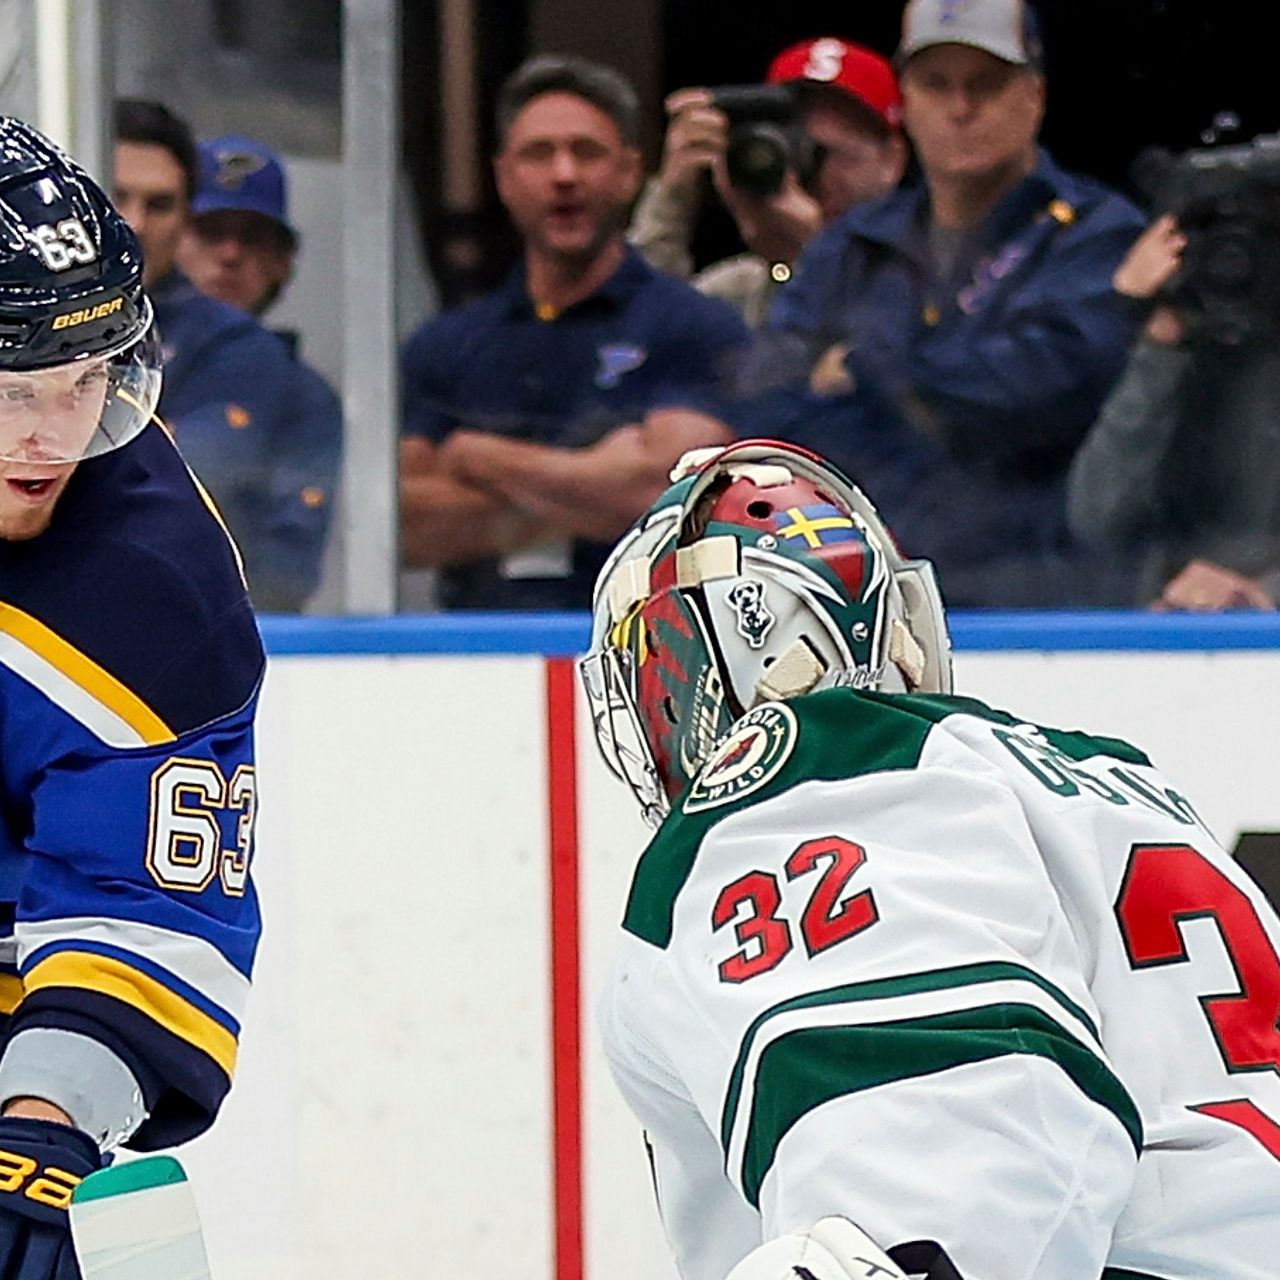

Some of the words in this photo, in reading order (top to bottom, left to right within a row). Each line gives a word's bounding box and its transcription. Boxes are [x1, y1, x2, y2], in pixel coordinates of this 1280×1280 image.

[804, 37, 847, 81] S
[33, 217, 96, 272] 63
[52, 298, 123, 330] BAUER
[708, 765, 765, 800] WILD
[144, 756, 257, 896] 63
[712, 834, 881, 985] 32
